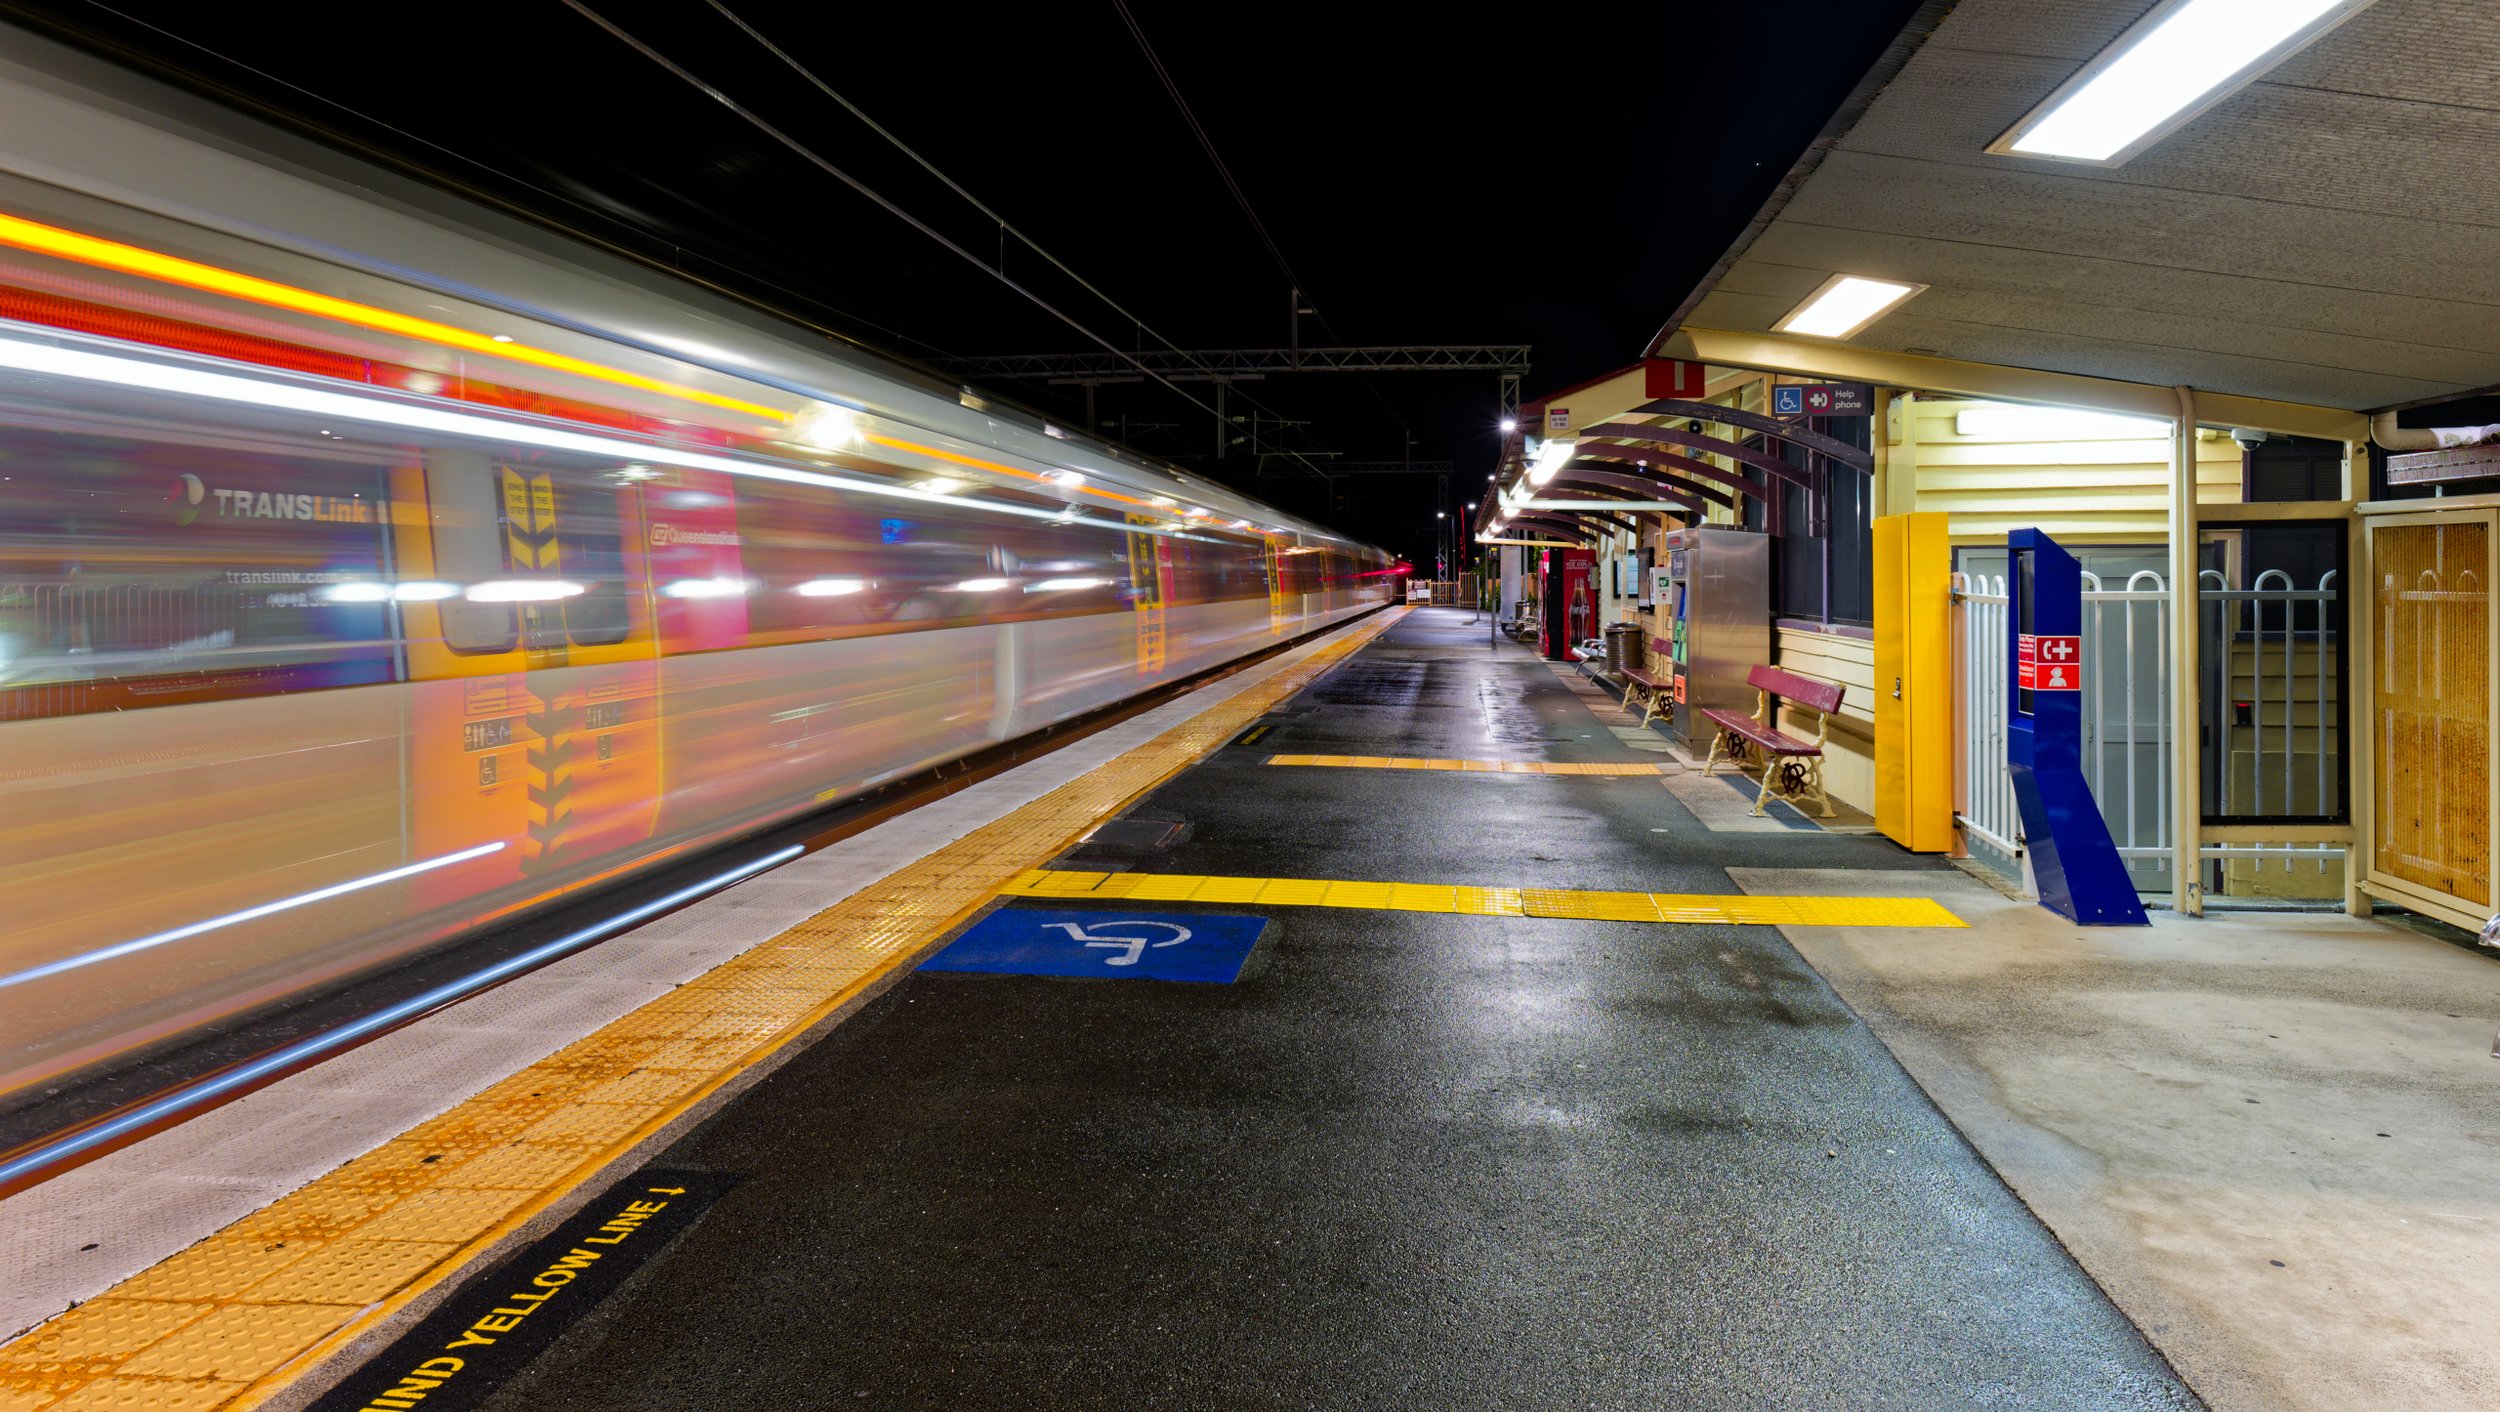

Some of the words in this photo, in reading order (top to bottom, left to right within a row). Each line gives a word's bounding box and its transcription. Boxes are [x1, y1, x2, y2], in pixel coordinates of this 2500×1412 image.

[1835, 390, 1855, 399] Help
[1835, 401, 1862, 410] phone
[214, 488, 369, 523] TRANSLink
[445, 1248, 602, 1350] YELLOW
[584, 1200, 669, 1245] LINE
